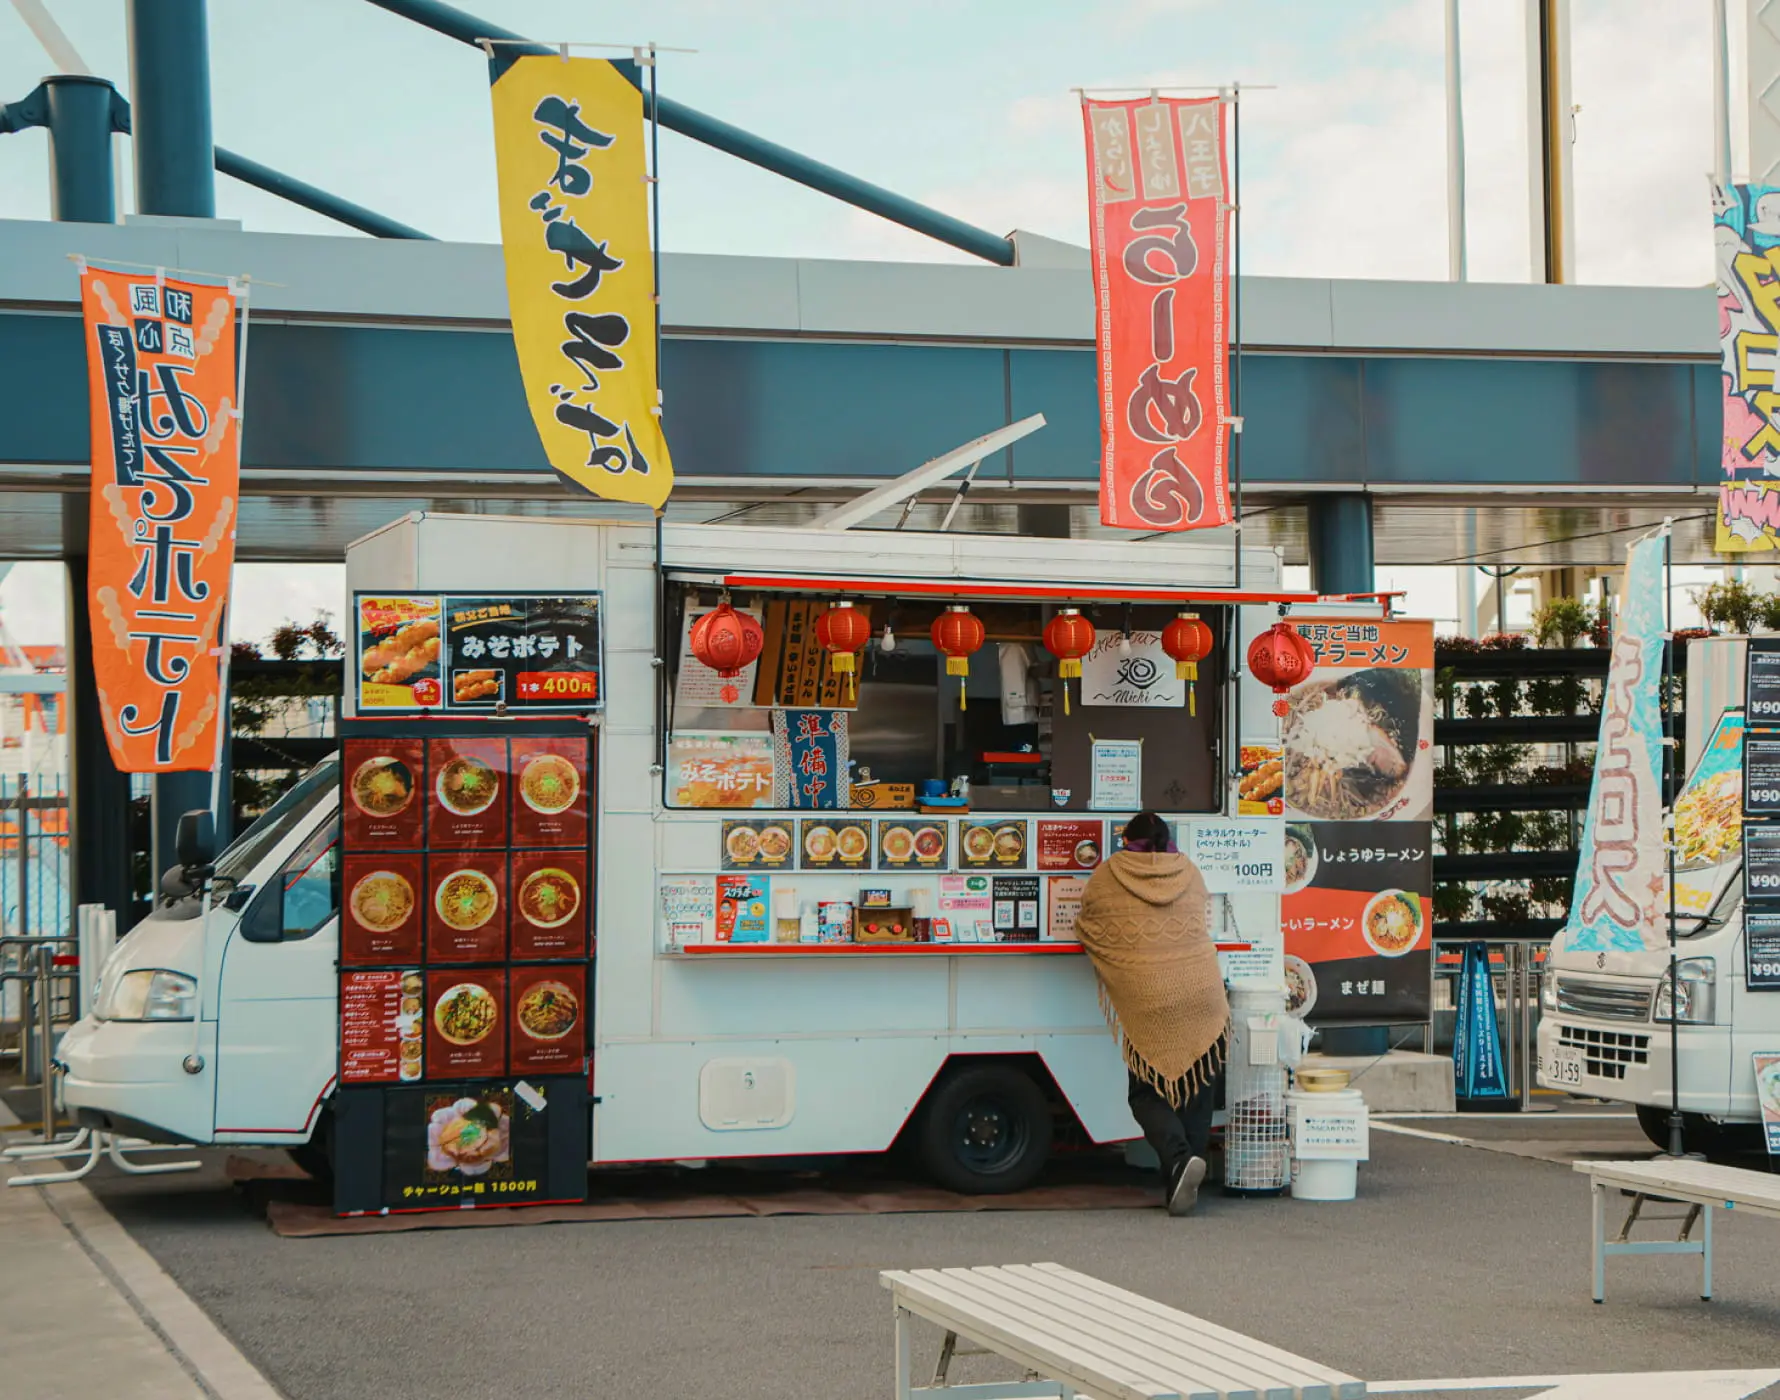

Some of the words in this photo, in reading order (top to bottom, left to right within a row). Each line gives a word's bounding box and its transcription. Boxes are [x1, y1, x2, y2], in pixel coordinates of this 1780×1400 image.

[1297, 624, 1379, 642] 東京ご当地
[462, 634, 584, 660] みそポテト
[1312, 642, 1410, 665] 子ラーメン
[543, 677, 592, 694] 400円
[795, 713, 829, 808] 準備中
[1196, 828, 1268, 839] ミネラルウォーター
[1322, 847, 1426, 863] しょうゆラーメン
[1234, 862, 1273, 877] 100円
[1281, 917, 1355, 931] いラーメン
[1340, 980, 1386, 996] まぜ麺
[402, 1182, 486, 1199] チャーシュー麺
[490, 1179, 538, 1194] 1500円
